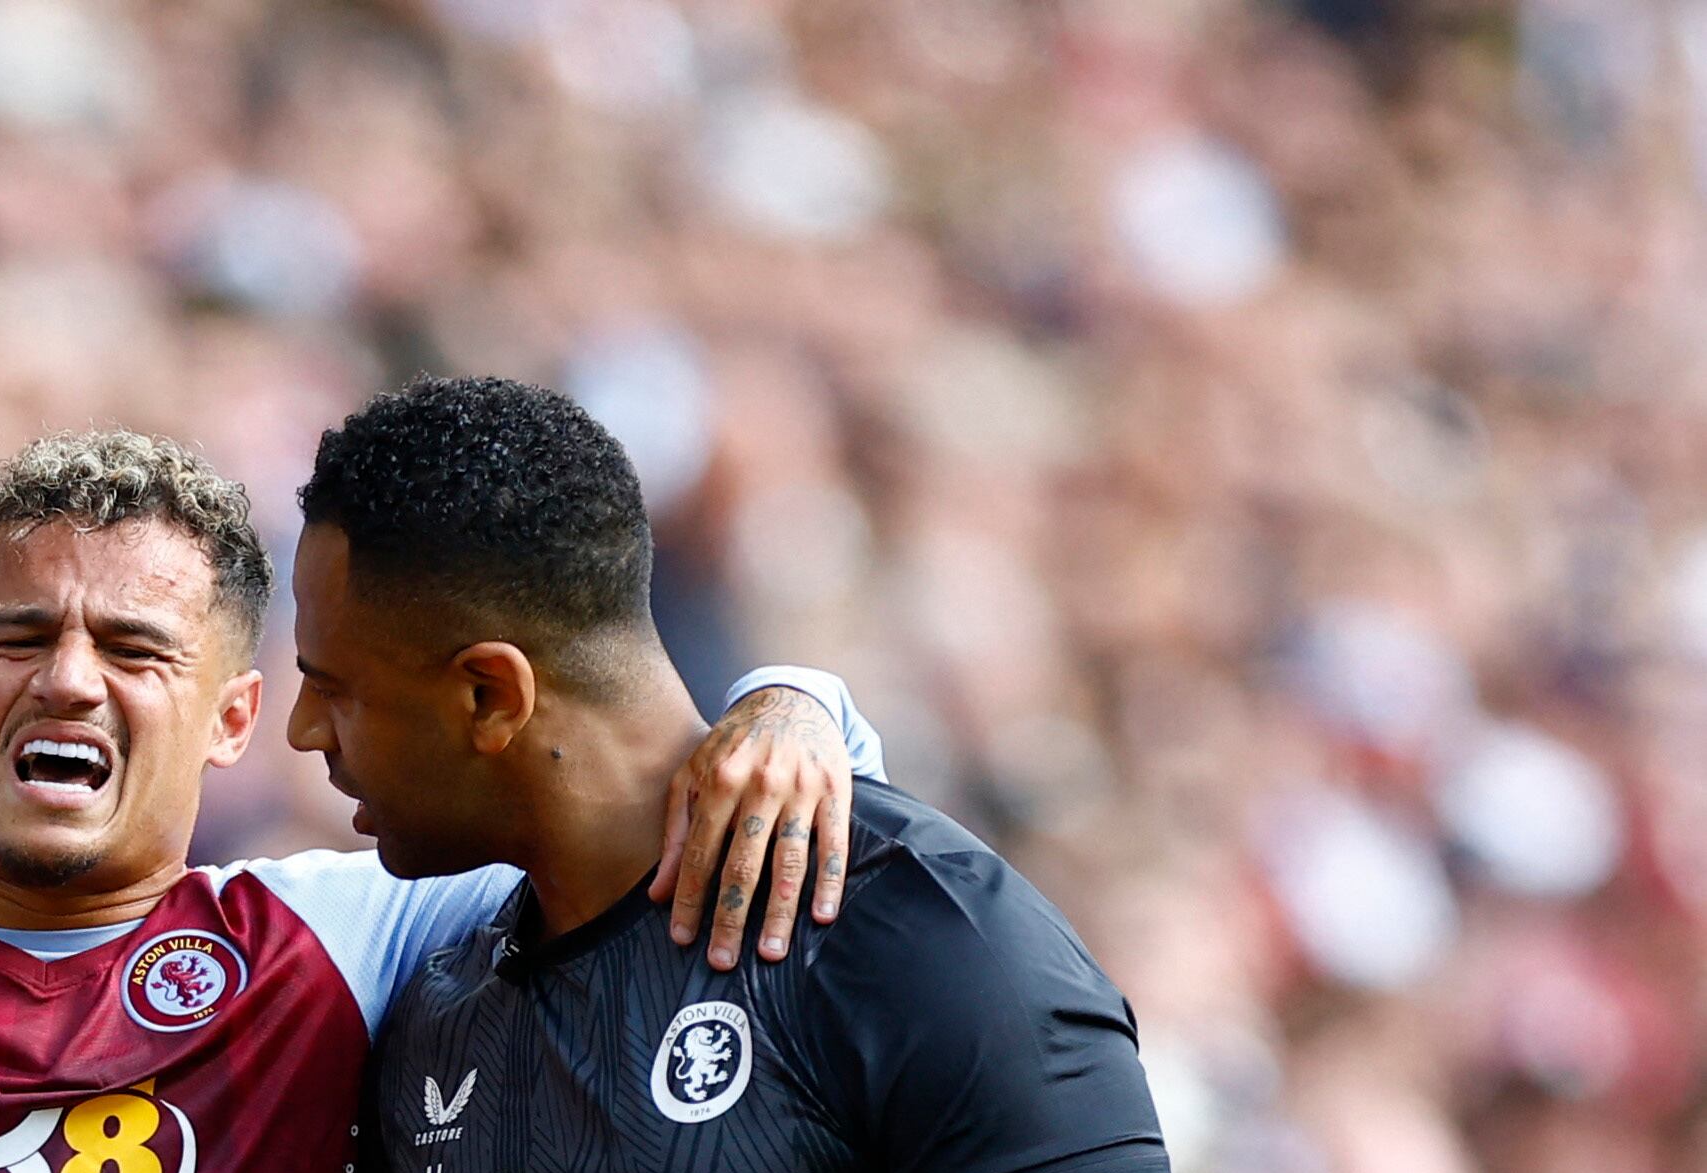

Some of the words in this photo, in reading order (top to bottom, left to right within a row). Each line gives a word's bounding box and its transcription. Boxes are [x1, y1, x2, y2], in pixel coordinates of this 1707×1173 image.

[132, 944, 167, 986] ASTON
[168, 938, 213, 954] VILLA
[193, 1007, 215, 1020] 1874
[665, 1007, 707, 1046] ASTON
[713, 1005, 747, 1033] VILLA
[690, 1107, 711, 1117] 1874
[415, 1126, 463, 1146] CASTORE
